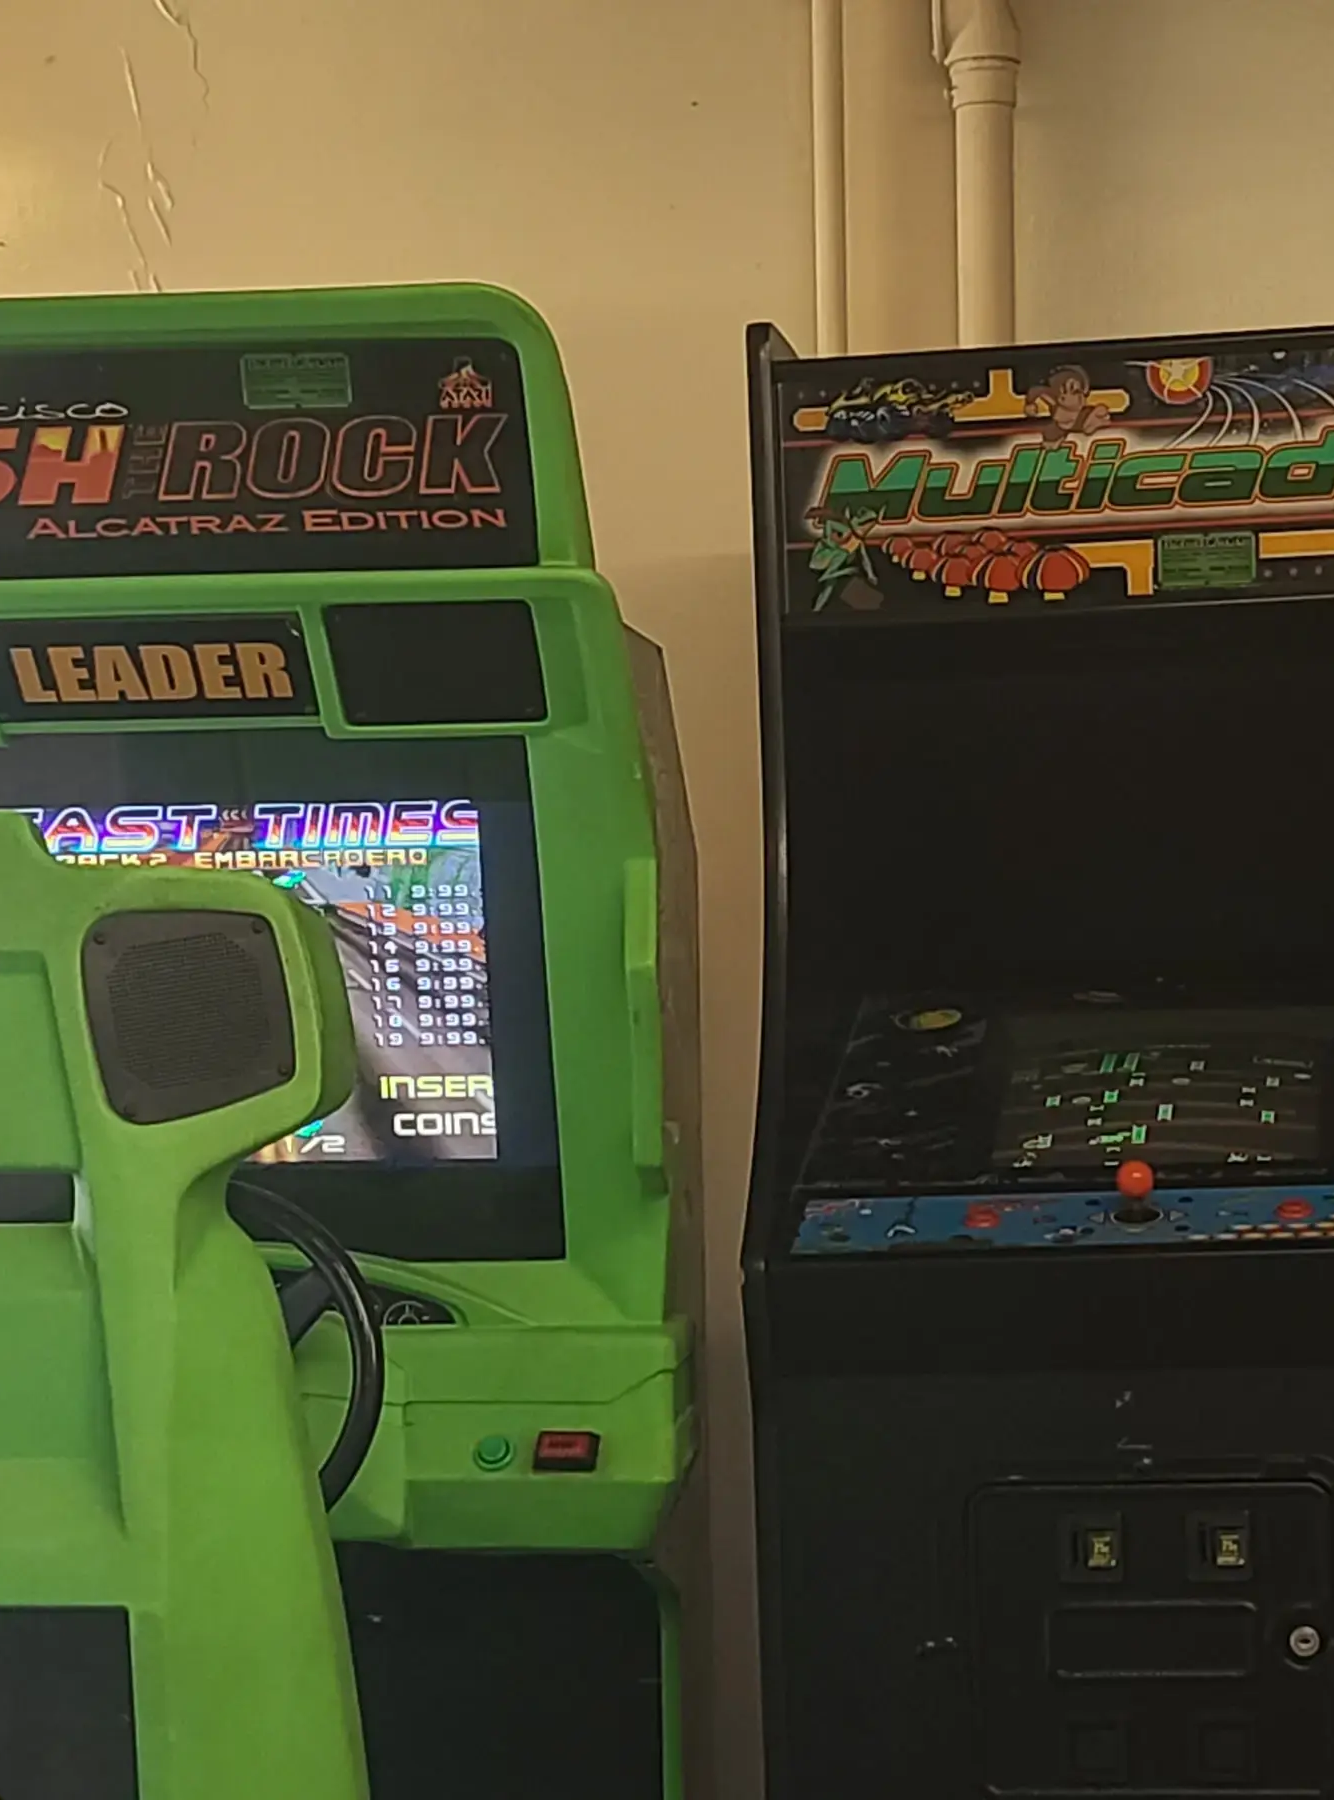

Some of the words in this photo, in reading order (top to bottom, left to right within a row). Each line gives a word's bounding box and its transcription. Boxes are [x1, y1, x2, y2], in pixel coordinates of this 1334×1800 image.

[122, 423, 169, 500] THE
[157, 413, 509, 501] ROCK
[26, 513, 290, 540] ALCATRAZ
[303, 507, 507, 532] EDITION
[9, 642, 294, 704] LEADER
[253, 799, 479, 847] TIMES
[365, 885, 392, 899] 11
[367, 903, 397, 917] 12
[367, 922, 396, 936] 13
[369, 941, 398, 955] 14
[371, 977, 401, 991] 16
[372, 995, 402, 1010] 17
[375, 1032, 404, 1046] 19
[380, 1075, 493, 1099] INSER
